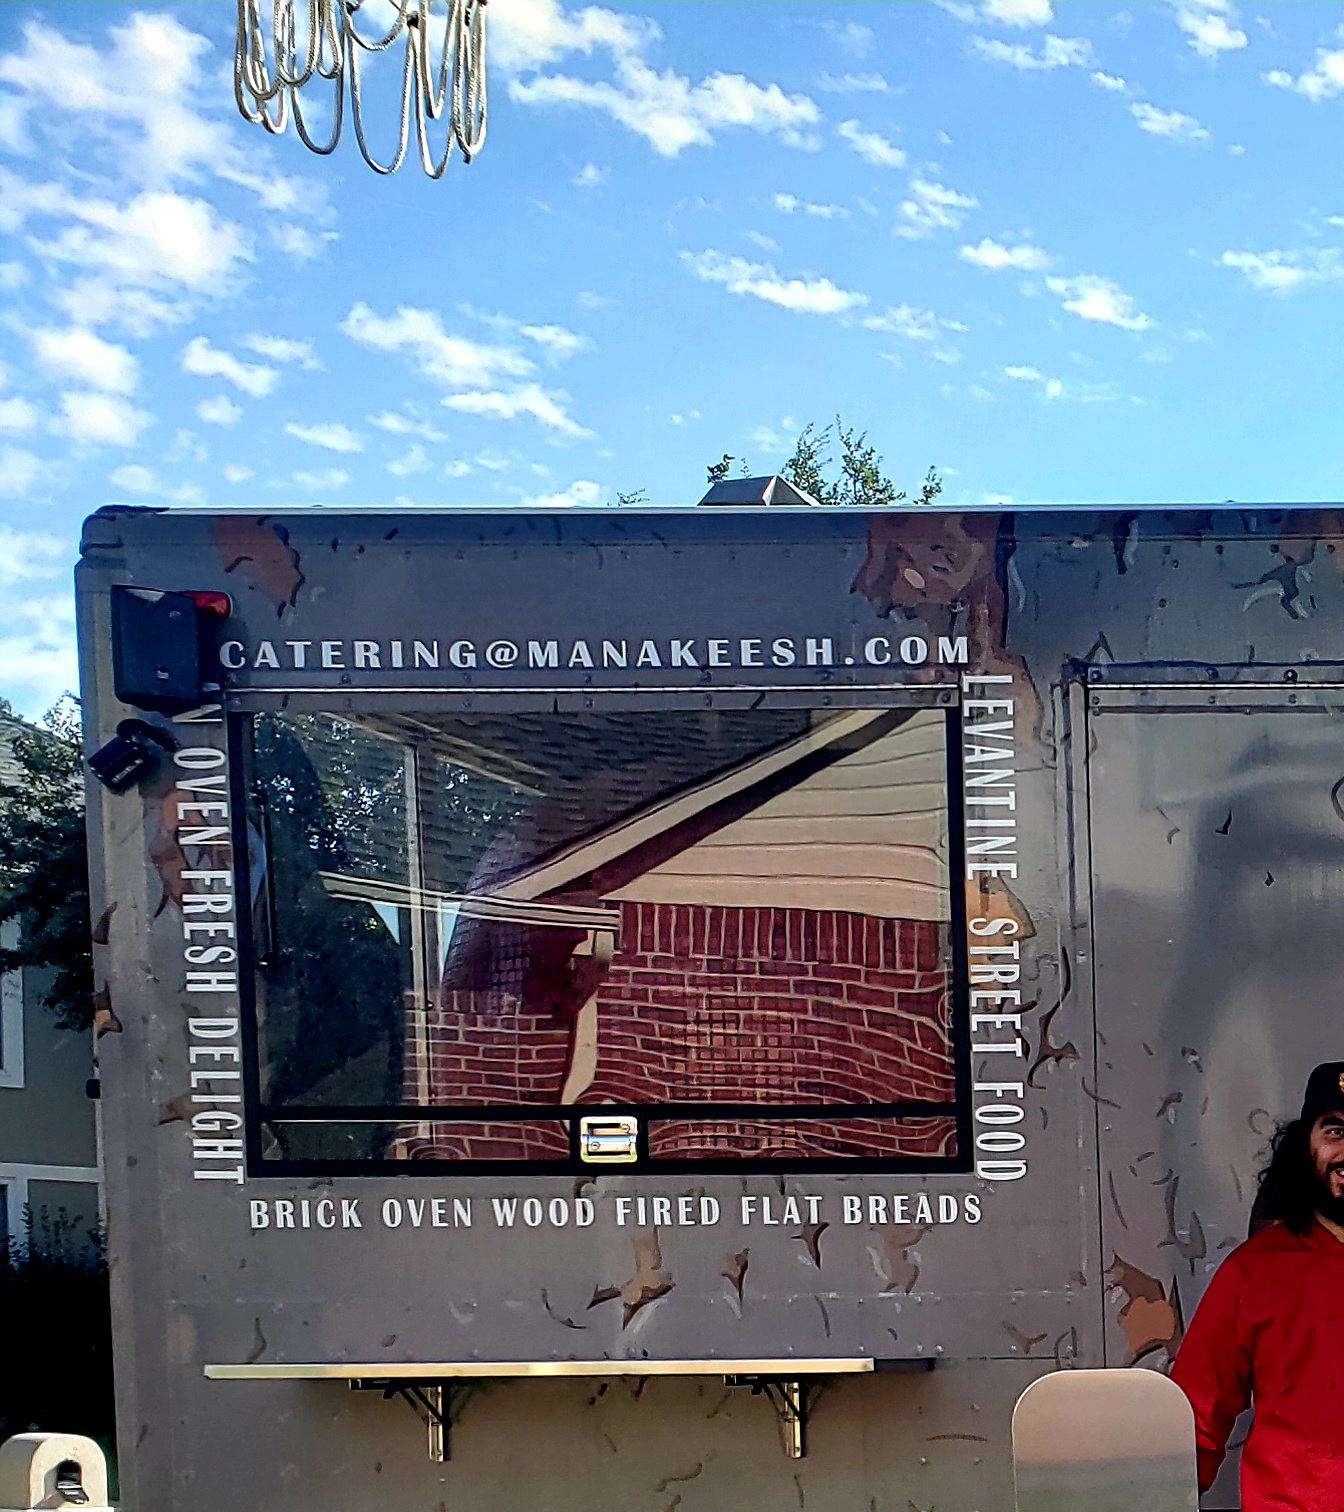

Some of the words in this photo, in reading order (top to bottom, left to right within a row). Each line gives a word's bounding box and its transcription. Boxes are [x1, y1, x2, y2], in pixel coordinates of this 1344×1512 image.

[219, 635, 970, 669] CATERING@MANAKEESH.COM
[173, 747, 233, 845] OVEN
[962, 675, 1017, 880] LEVANTINE
[180, 869, 238, 993] FRESH
[968, 917, 1022, 1058] STREET
[187, 1016, 245, 1185] DELIGHT
[973, 1081, 1027, 1181] FOOD
[250, 1199, 363, 1229] BRICK
[381, 1198, 473, 1228] OVEN
[492, 1197, 596, 1227] WOOD
[615, 1196, 721, 1226] FIRED
[741, 1195, 825, 1225] FLAT
[842, 1194, 983, 1225] BREADS
